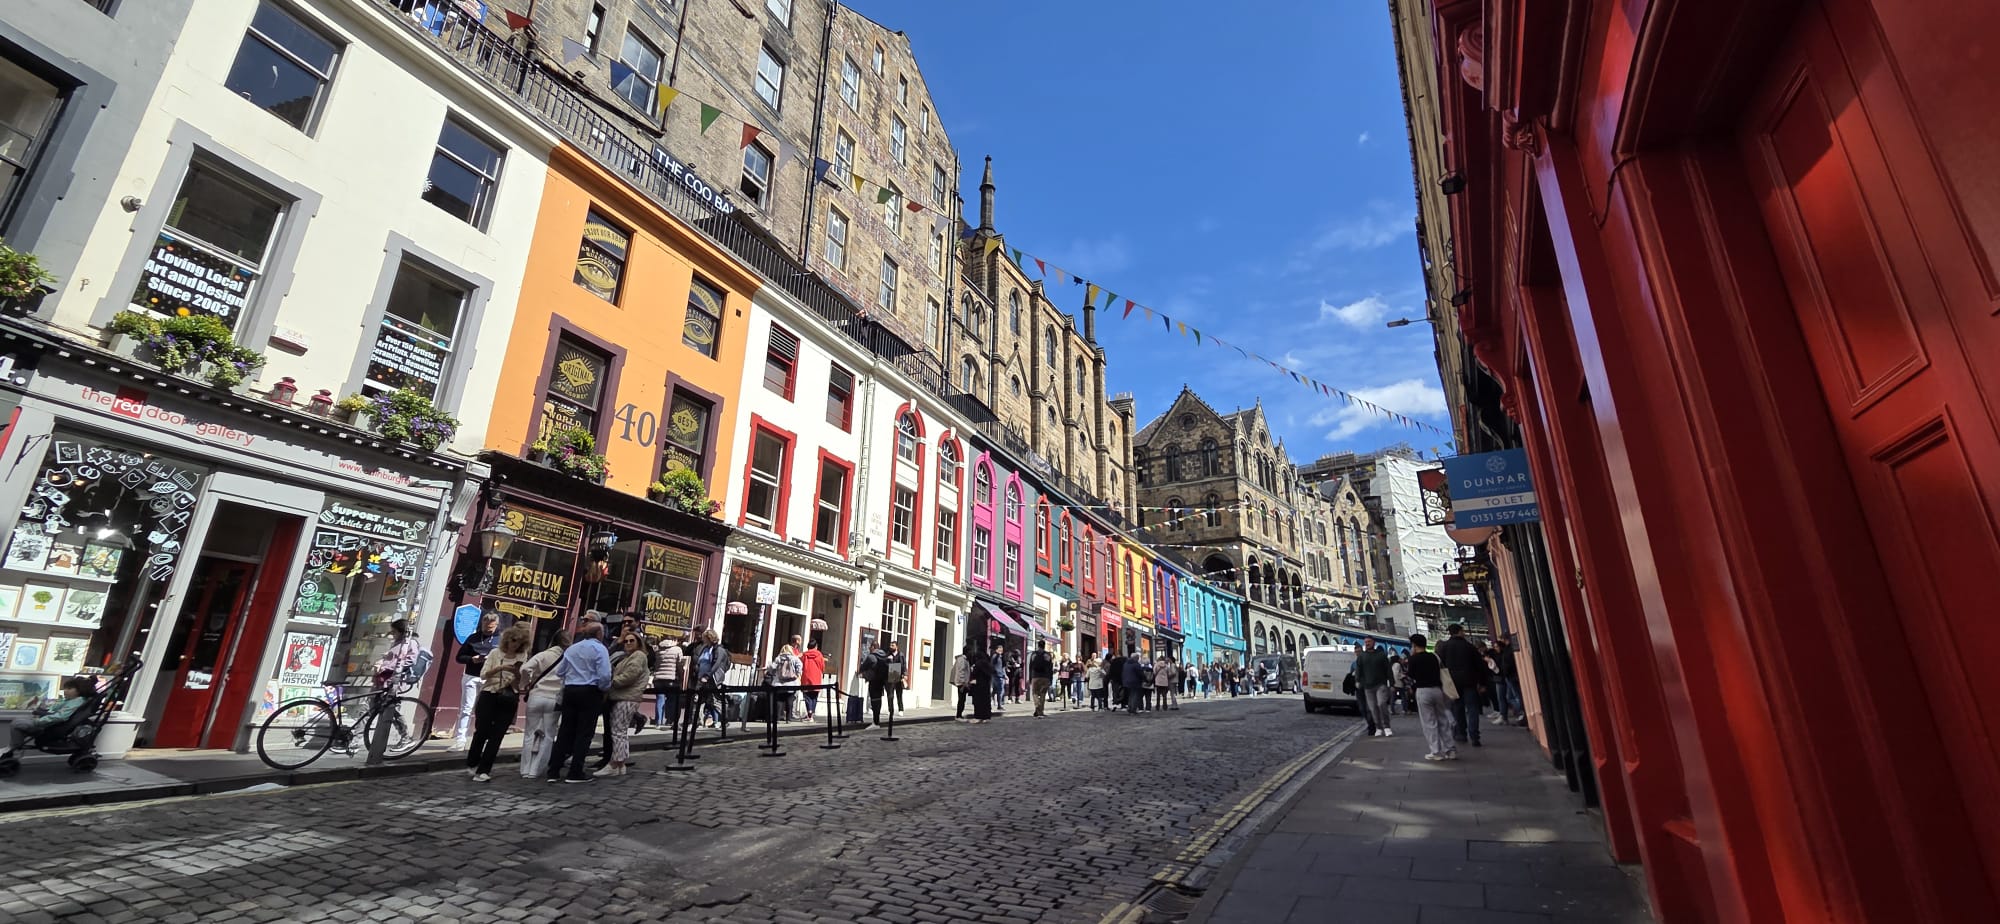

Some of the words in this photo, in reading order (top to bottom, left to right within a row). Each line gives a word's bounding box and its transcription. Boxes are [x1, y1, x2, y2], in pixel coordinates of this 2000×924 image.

[656, 148, 683, 179] THE
[684, 173, 712, 201] COO
[156, 248, 205, 278] Loving
[206, 268, 244, 293] Local
[143, 259, 169, 278] Art
[168, 270, 198, 289] and
[196, 280, 245, 308] Design
[147, 276, 192, 302] Since
[191, 293, 230, 317] 2003
[377, 340, 388, 350] Art
[388, 343, 409, 358] Prints,
[385, 335, 402, 346] Over
[401, 341, 414, 351] 150
[413, 347, 437, 360] Artists!
[371, 353, 399, 369] Creative
[399, 364, 414, 375] Gifts
[420, 372, 440, 384] Cards
[405, 358, 439, 377] Homeware
[563, 362, 591, 382] ORIGINAL
[81, 386, 112, 406] the
[113, 397, 144, 414] red
[146, 404, 187, 427] door
[196, 421, 255, 447] gallery
[549, 411, 582, 427] WORLD
[614, 402, 656, 448] 40
[677, 415, 693, 428] BEST
[1463, 472, 1527, 489] DUNPAR
[1484, 498, 1500, 507] TO
[1505, 495, 1525, 505] LET
[331, 503, 382, 523] SUPPORT
[383, 517, 410, 529] LOCAL
[1471, 513, 1494, 523] 0131
[1496, 510, 1516, 520] 557
[1518, 508, 1538, 517] 446
[335, 516, 362, 529] Artists
[363, 522, 371, 532] &
[372, 524, 402, 537] Makers
[498, 563, 564, 594] MUSEUM
[508, 585, 549, 602] CONTEXT
[646, 594, 692, 618] MUSEUM
[653, 611, 681, 625] CONTEXT
[291, 638, 326, 647] WOMEN
[282, 677, 318, 685] HISTORY
